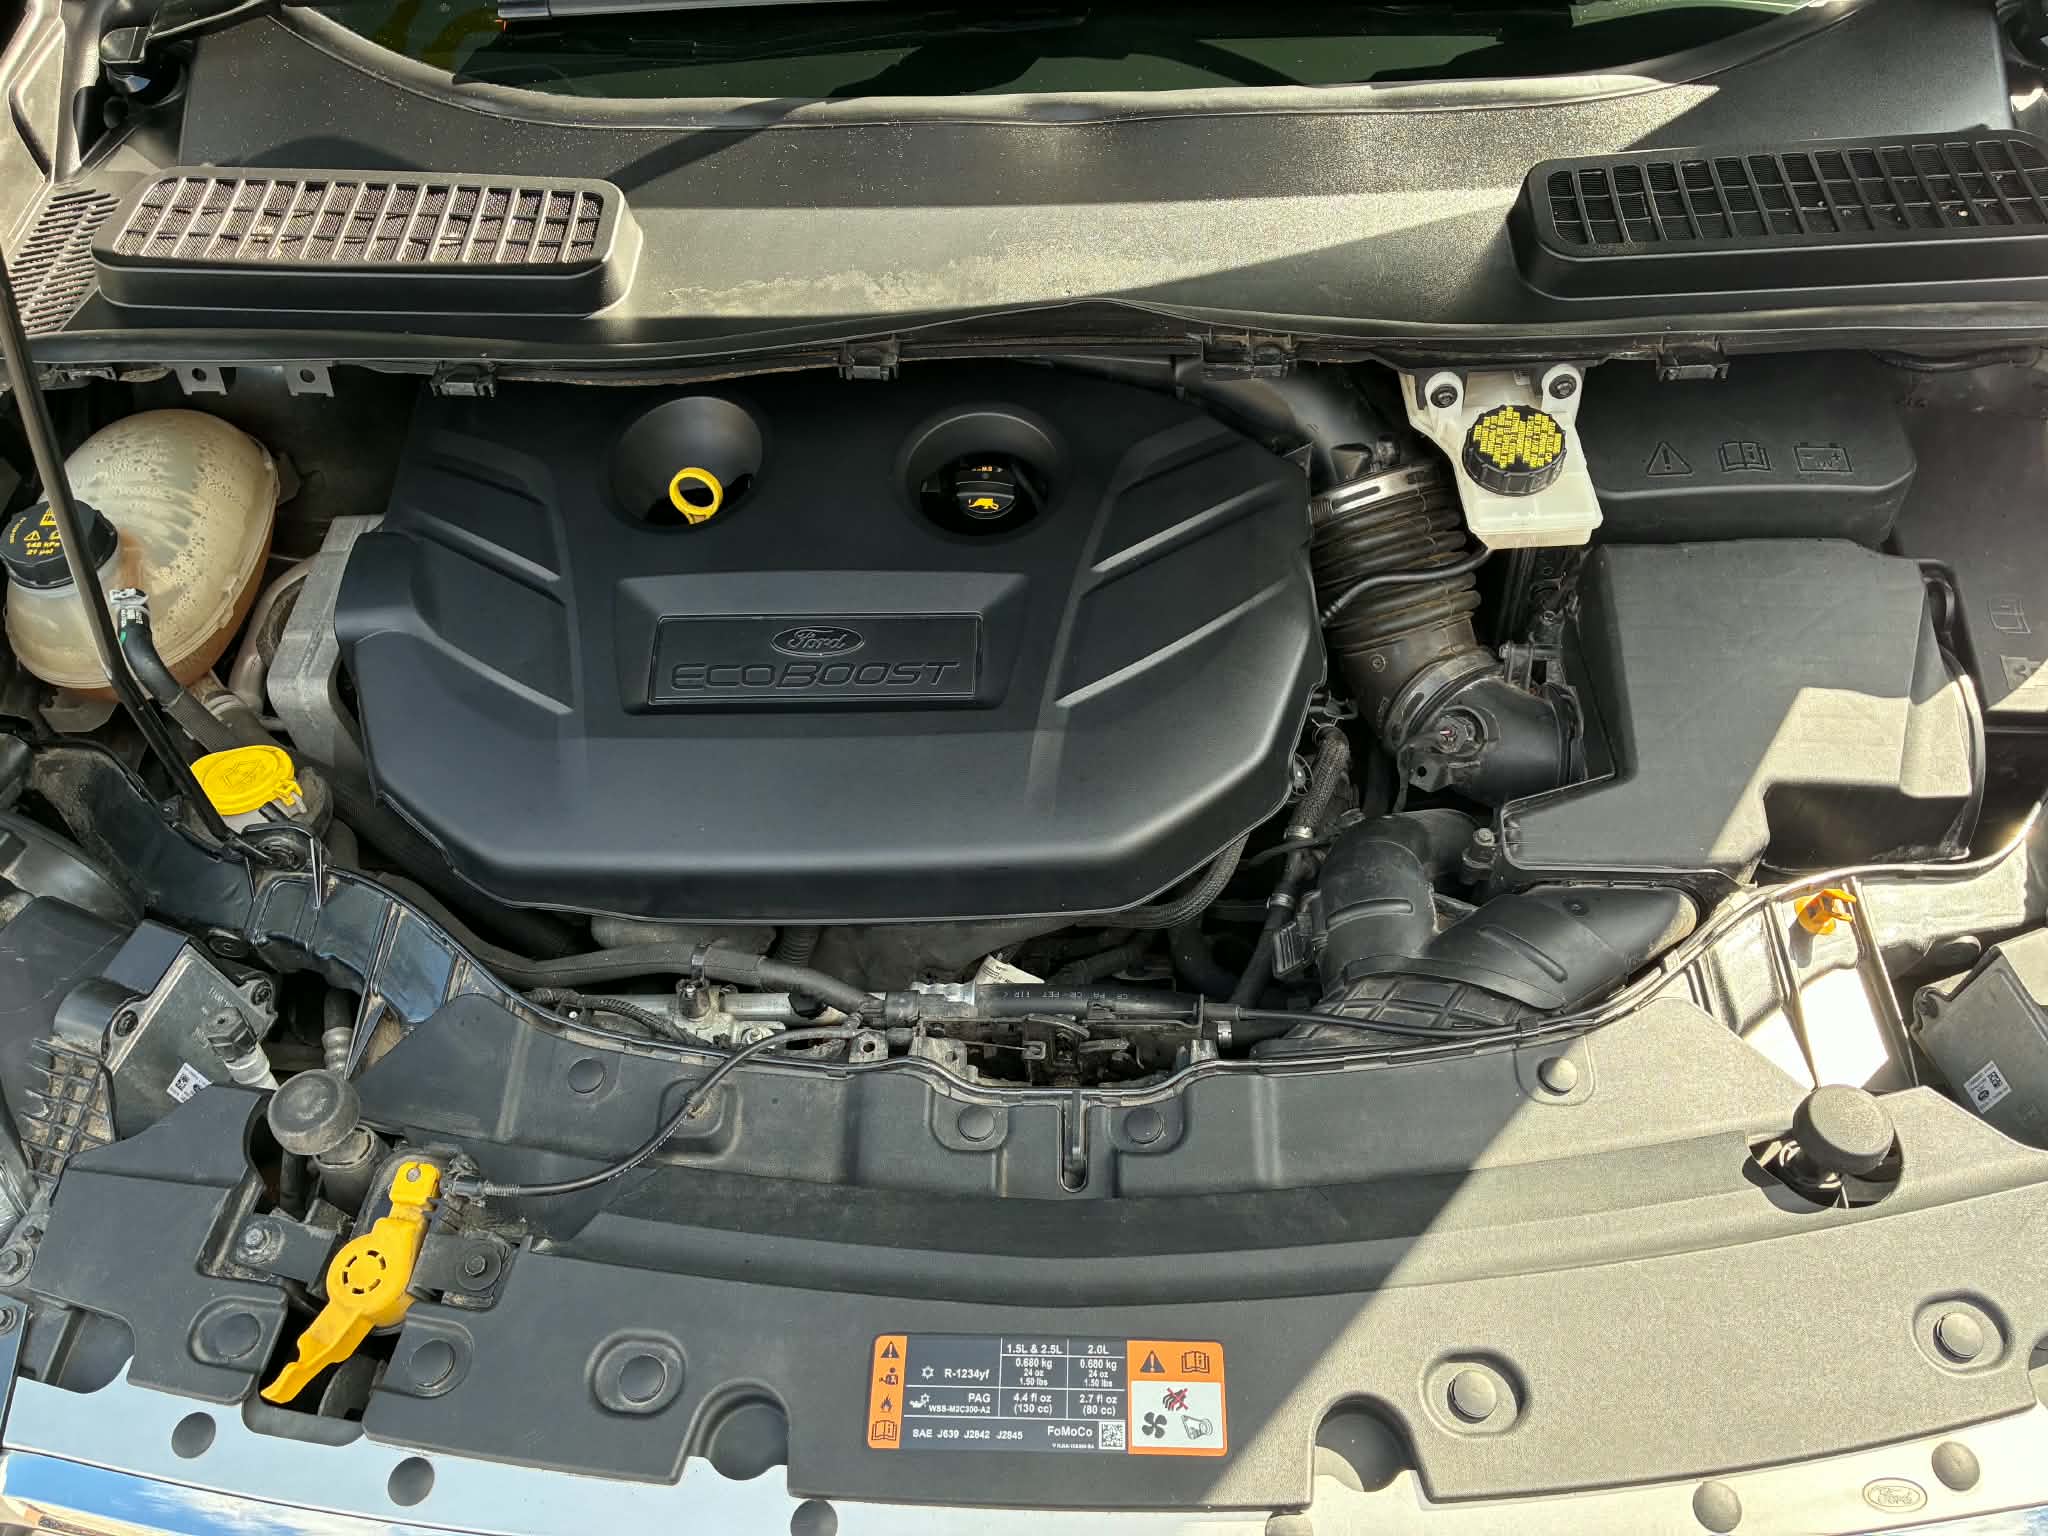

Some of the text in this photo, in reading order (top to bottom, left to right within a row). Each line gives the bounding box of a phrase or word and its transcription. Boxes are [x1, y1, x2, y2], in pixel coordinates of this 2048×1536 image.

[788, 629, 846, 651] Ford
[670, 661, 961, 691] ECOBOOST
[1007, 1344, 1063, 1354] 1.5L & 2.5L
[1087, 1345, 1110, 1354] 2.0L
[1015, 1358, 1053, 1370] 0.680 kg
[1080, 1359, 1117, 1371] 0.680 kg
[944, 1368, 990, 1381] R-1234yf
[1023, 1368, 1033, 1377] 24
[1088, 1370, 1098, 1378] 24
[1019, 1378, 1048, 1386] 1.50 lbs
[1084, 1379, 1113, 1387] 1.50 lbs
[968, 1393, 991, 1403] PAG
[1013, 1393, 1028, 1402] 4.4
[1030, 1393, 1038, 1402] fl
[1079, 1394, 1118, 1404] 2.7 fl oz
[1014, 1403, 1052, 1414] (130 cc)
[1082, 1405, 1116, 1416] (80 cc)
[912, 1429, 1024, 1440] SAE J639 J2842 J2845
[1047, 1425, 1093, 1437] FoMoCo
